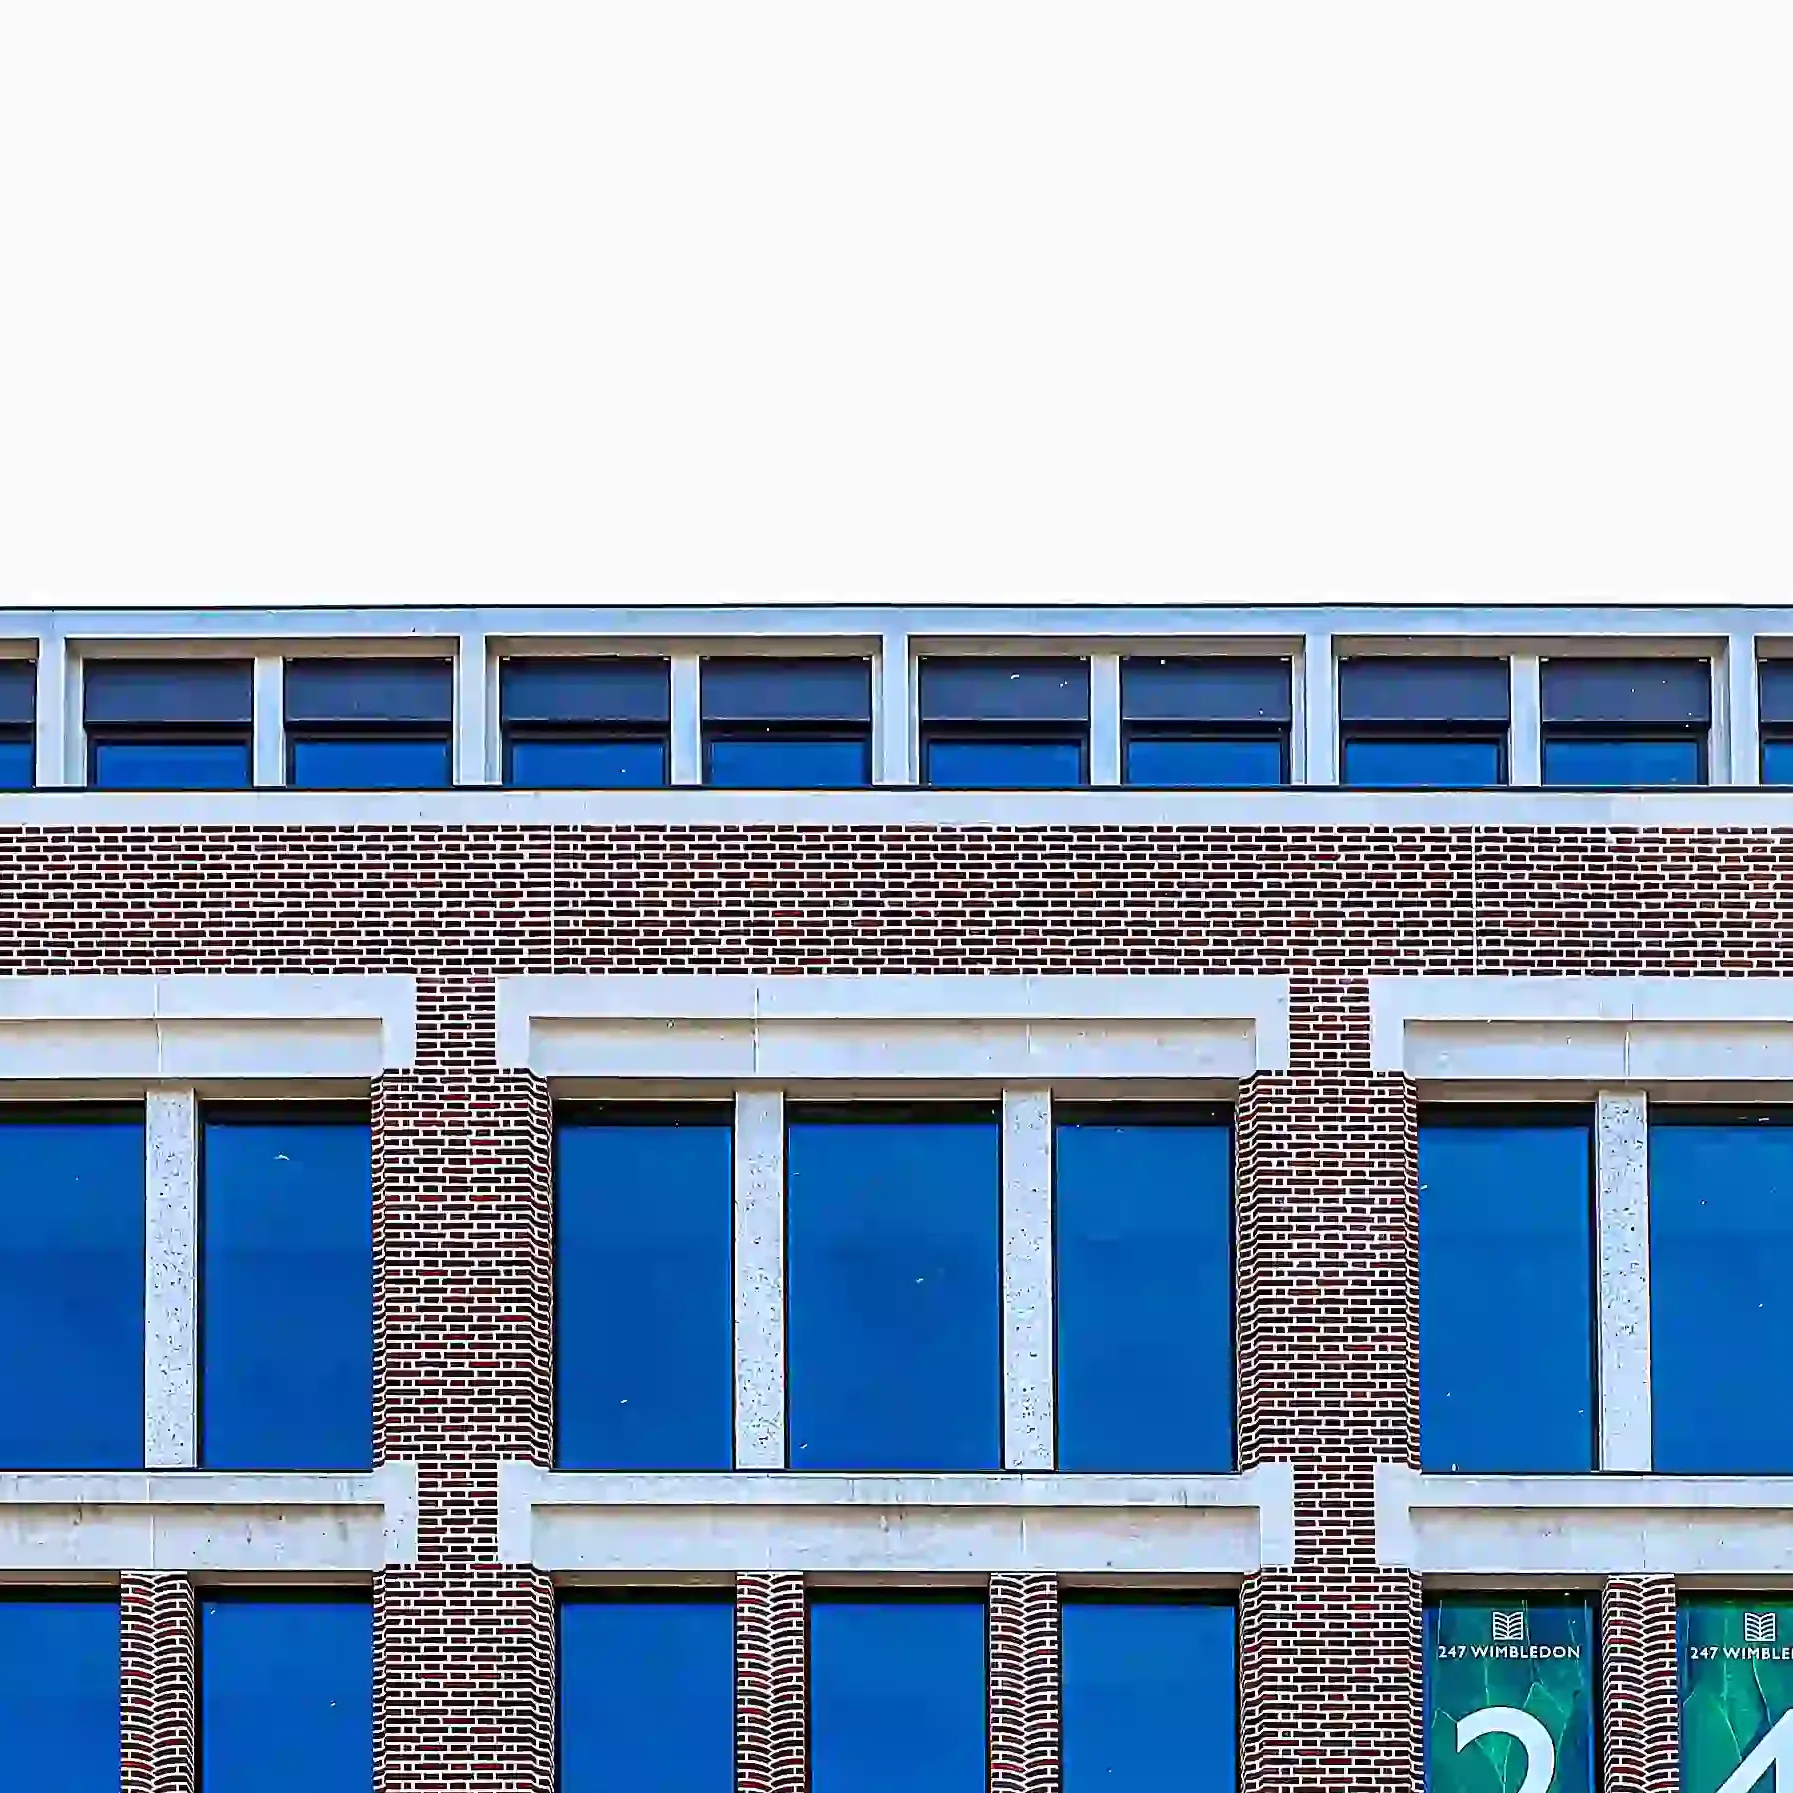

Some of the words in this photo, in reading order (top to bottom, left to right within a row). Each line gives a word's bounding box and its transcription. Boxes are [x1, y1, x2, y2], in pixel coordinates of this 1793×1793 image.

[1438, 1645, 1466, 1658] 247
[1470, 1645, 1580, 1659] WIMBLEDON
[1690, 1646, 1719, 1660] 247
